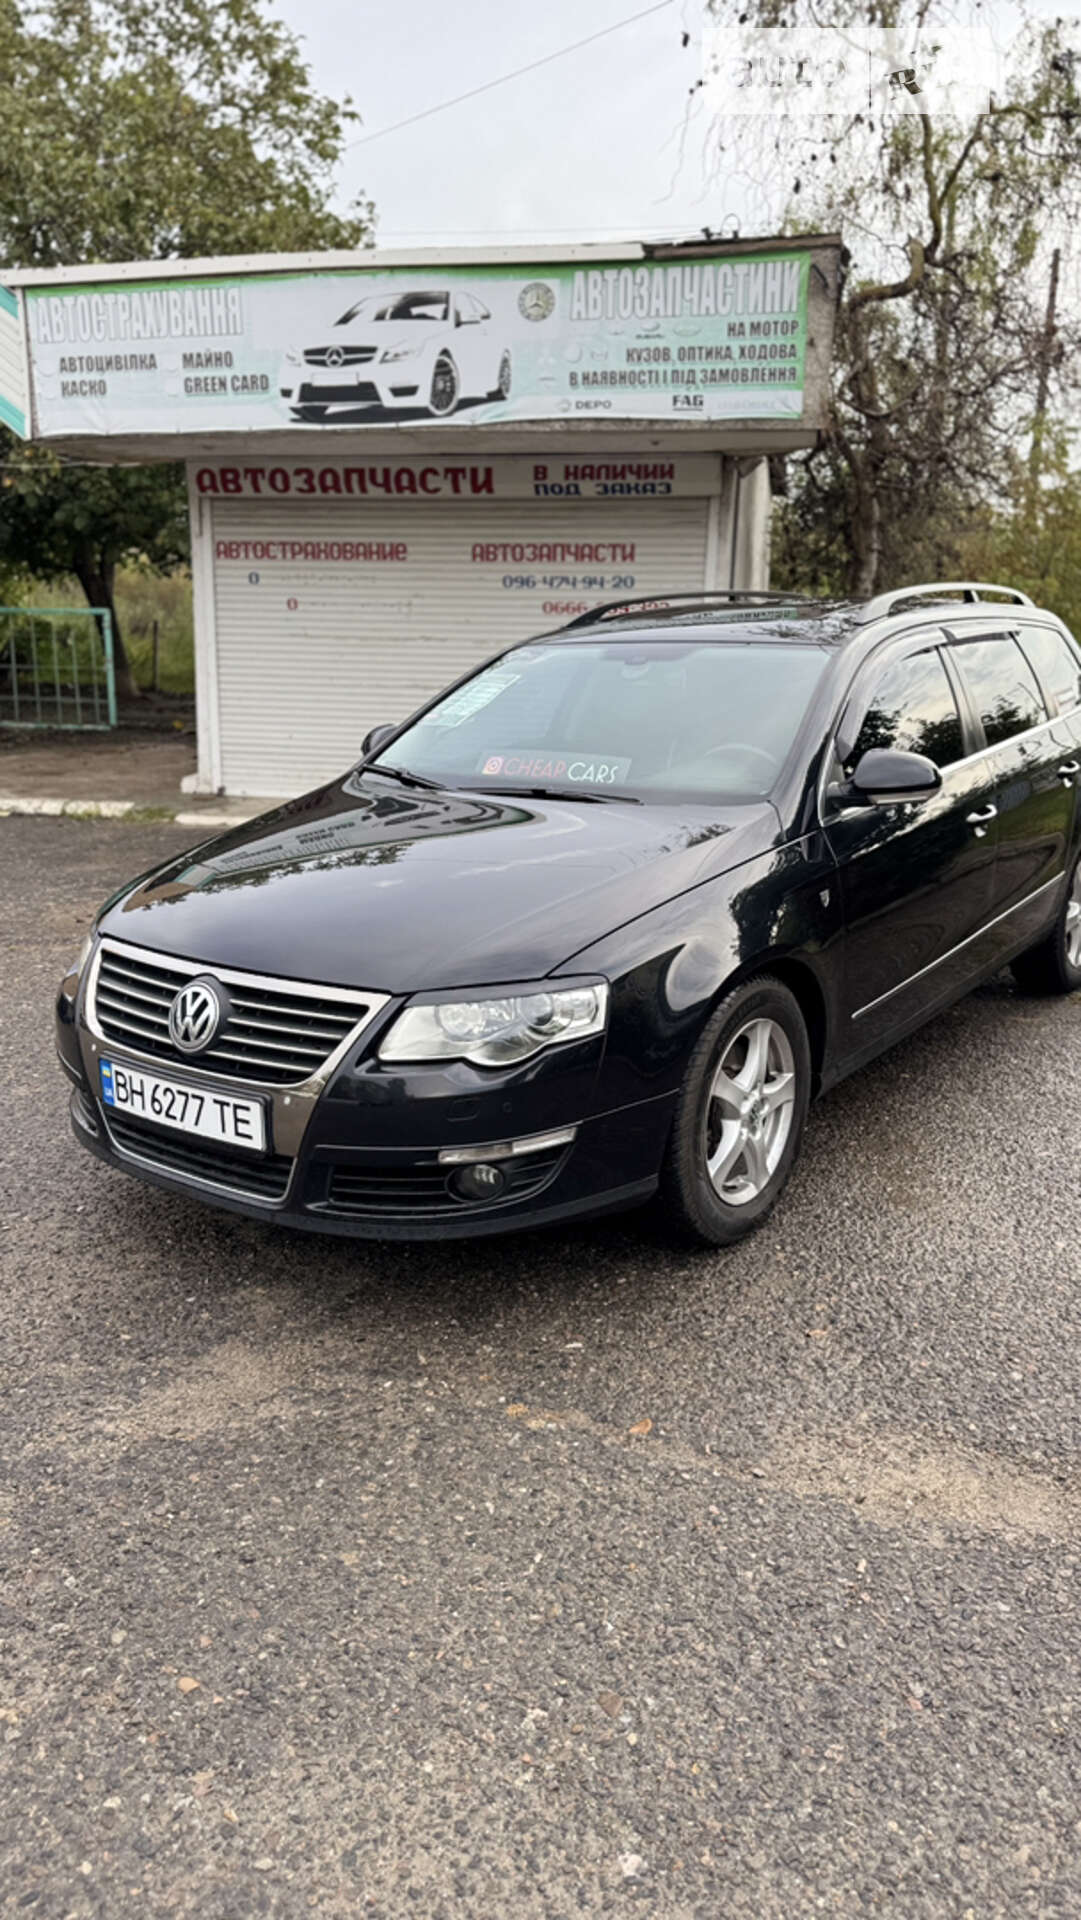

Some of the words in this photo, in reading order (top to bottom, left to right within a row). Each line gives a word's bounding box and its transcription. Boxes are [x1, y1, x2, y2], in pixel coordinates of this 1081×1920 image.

[570, 260, 801, 320] АВТОЗАПЧАСТИНИ
[36, 286, 244, 344] АВТОСТРАХУВАННЯ
[727, 322, 746, 338] НА
[749, 320, 799, 337] МОТОР
[182, 349, 234, 369] МАЙНО
[738, 344, 798, 362] ХОДОВА
[59, 353, 158, 375] АВТОЦИВІЛКА
[184, 376, 228, 395] GREEN
[231, 374, 270, 392] CARD
[569, 371, 579, 387] В
[582, 370, 660, 387] НАЯВНОСТІ
[671, 368, 697, 385] ПІД
[700, 367, 797, 384] ЗАМОВЛЕННЯ
[61, 379, 108, 397] КАСКО
[575, 400, 612, 410] DEPO
[672, 395, 704, 407] FAG
[196, 466, 495, 495] АВТОЗАПЧАСТИ
[533, 465, 549, 481] В
[564, 463, 675, 481] НАЛИЧИИ
[534, 483, 581, 497] ПОД
[595, 482, 673, 495] ЗАКАЗ
[216, 540, 408, 562] АВТОСТРАХОВАНИЕ
[472, 543, 636, 562] АВТОЗАПЧАСТИ
[503, 757, 567, 778] CHEAP
[567, 761, 619, 784] CARS
[115, 1070, 145, 1111] BH
[150, 1083, 205, 1127] 6277
[213, 1098, 253, 1140] TE
